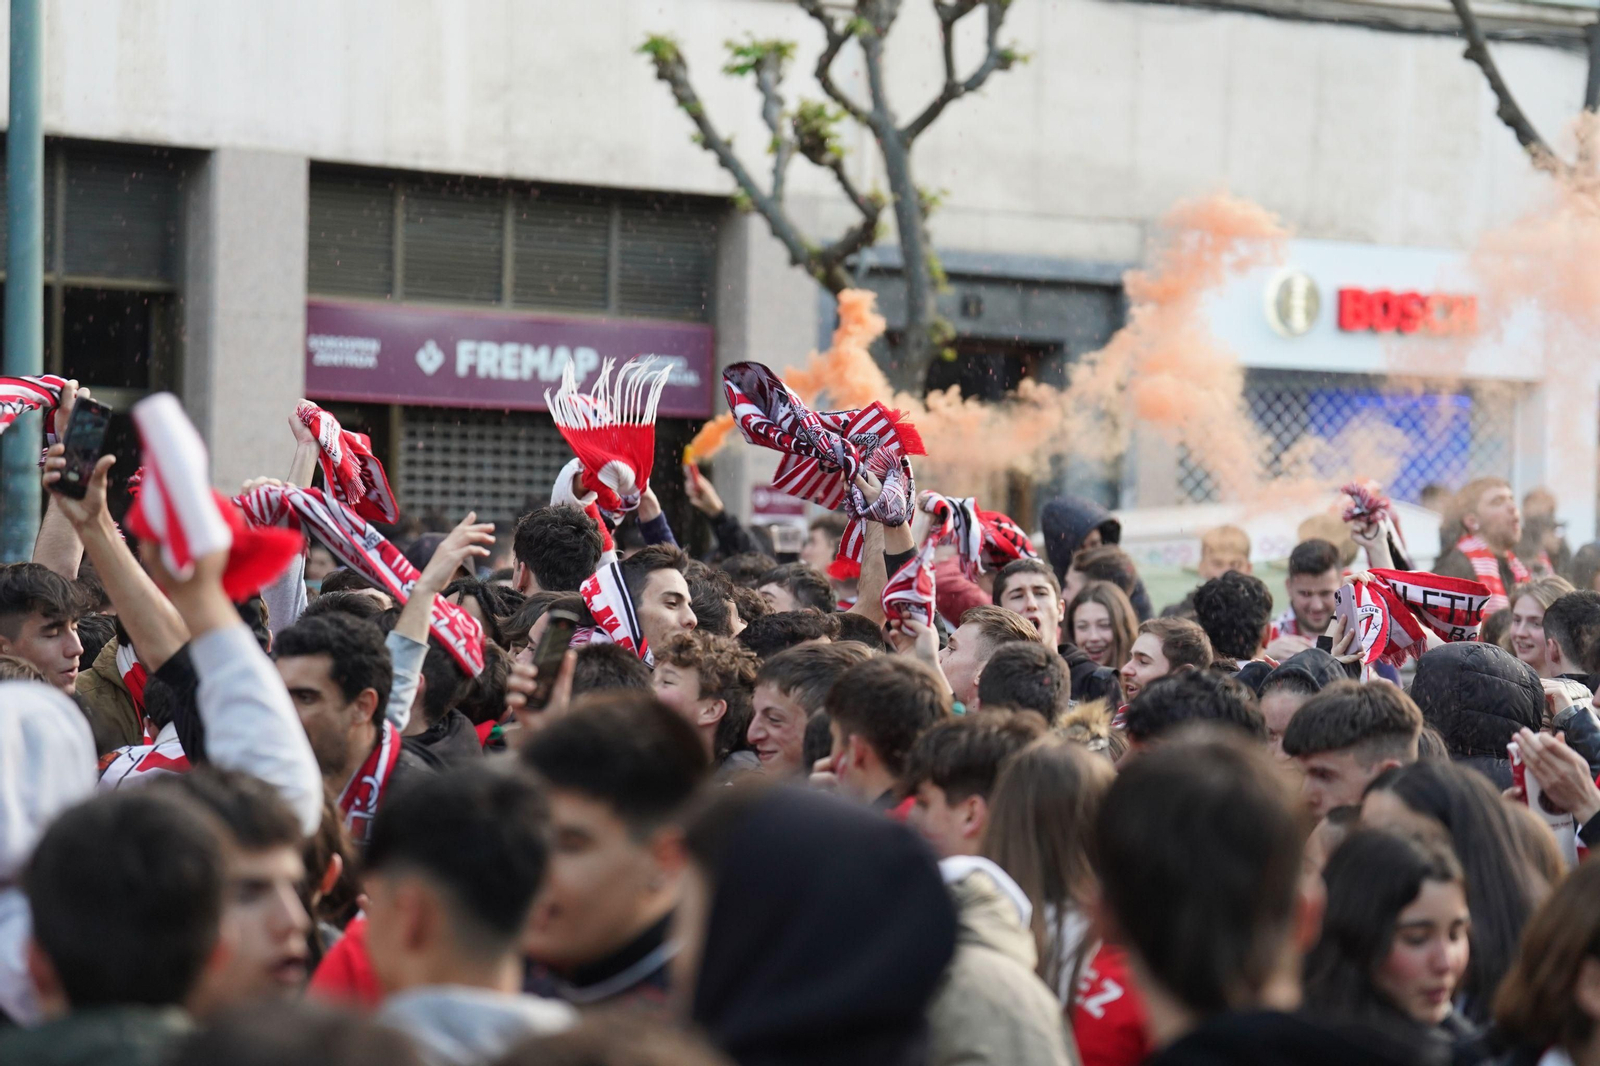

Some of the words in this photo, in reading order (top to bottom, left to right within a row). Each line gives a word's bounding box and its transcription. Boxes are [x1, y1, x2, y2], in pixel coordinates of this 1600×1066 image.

[1338, 288, 1478, 334] BOSCH
[456, 339, 599, 382] FREMAP
[1361, 606, 1380, 615] CLUB
